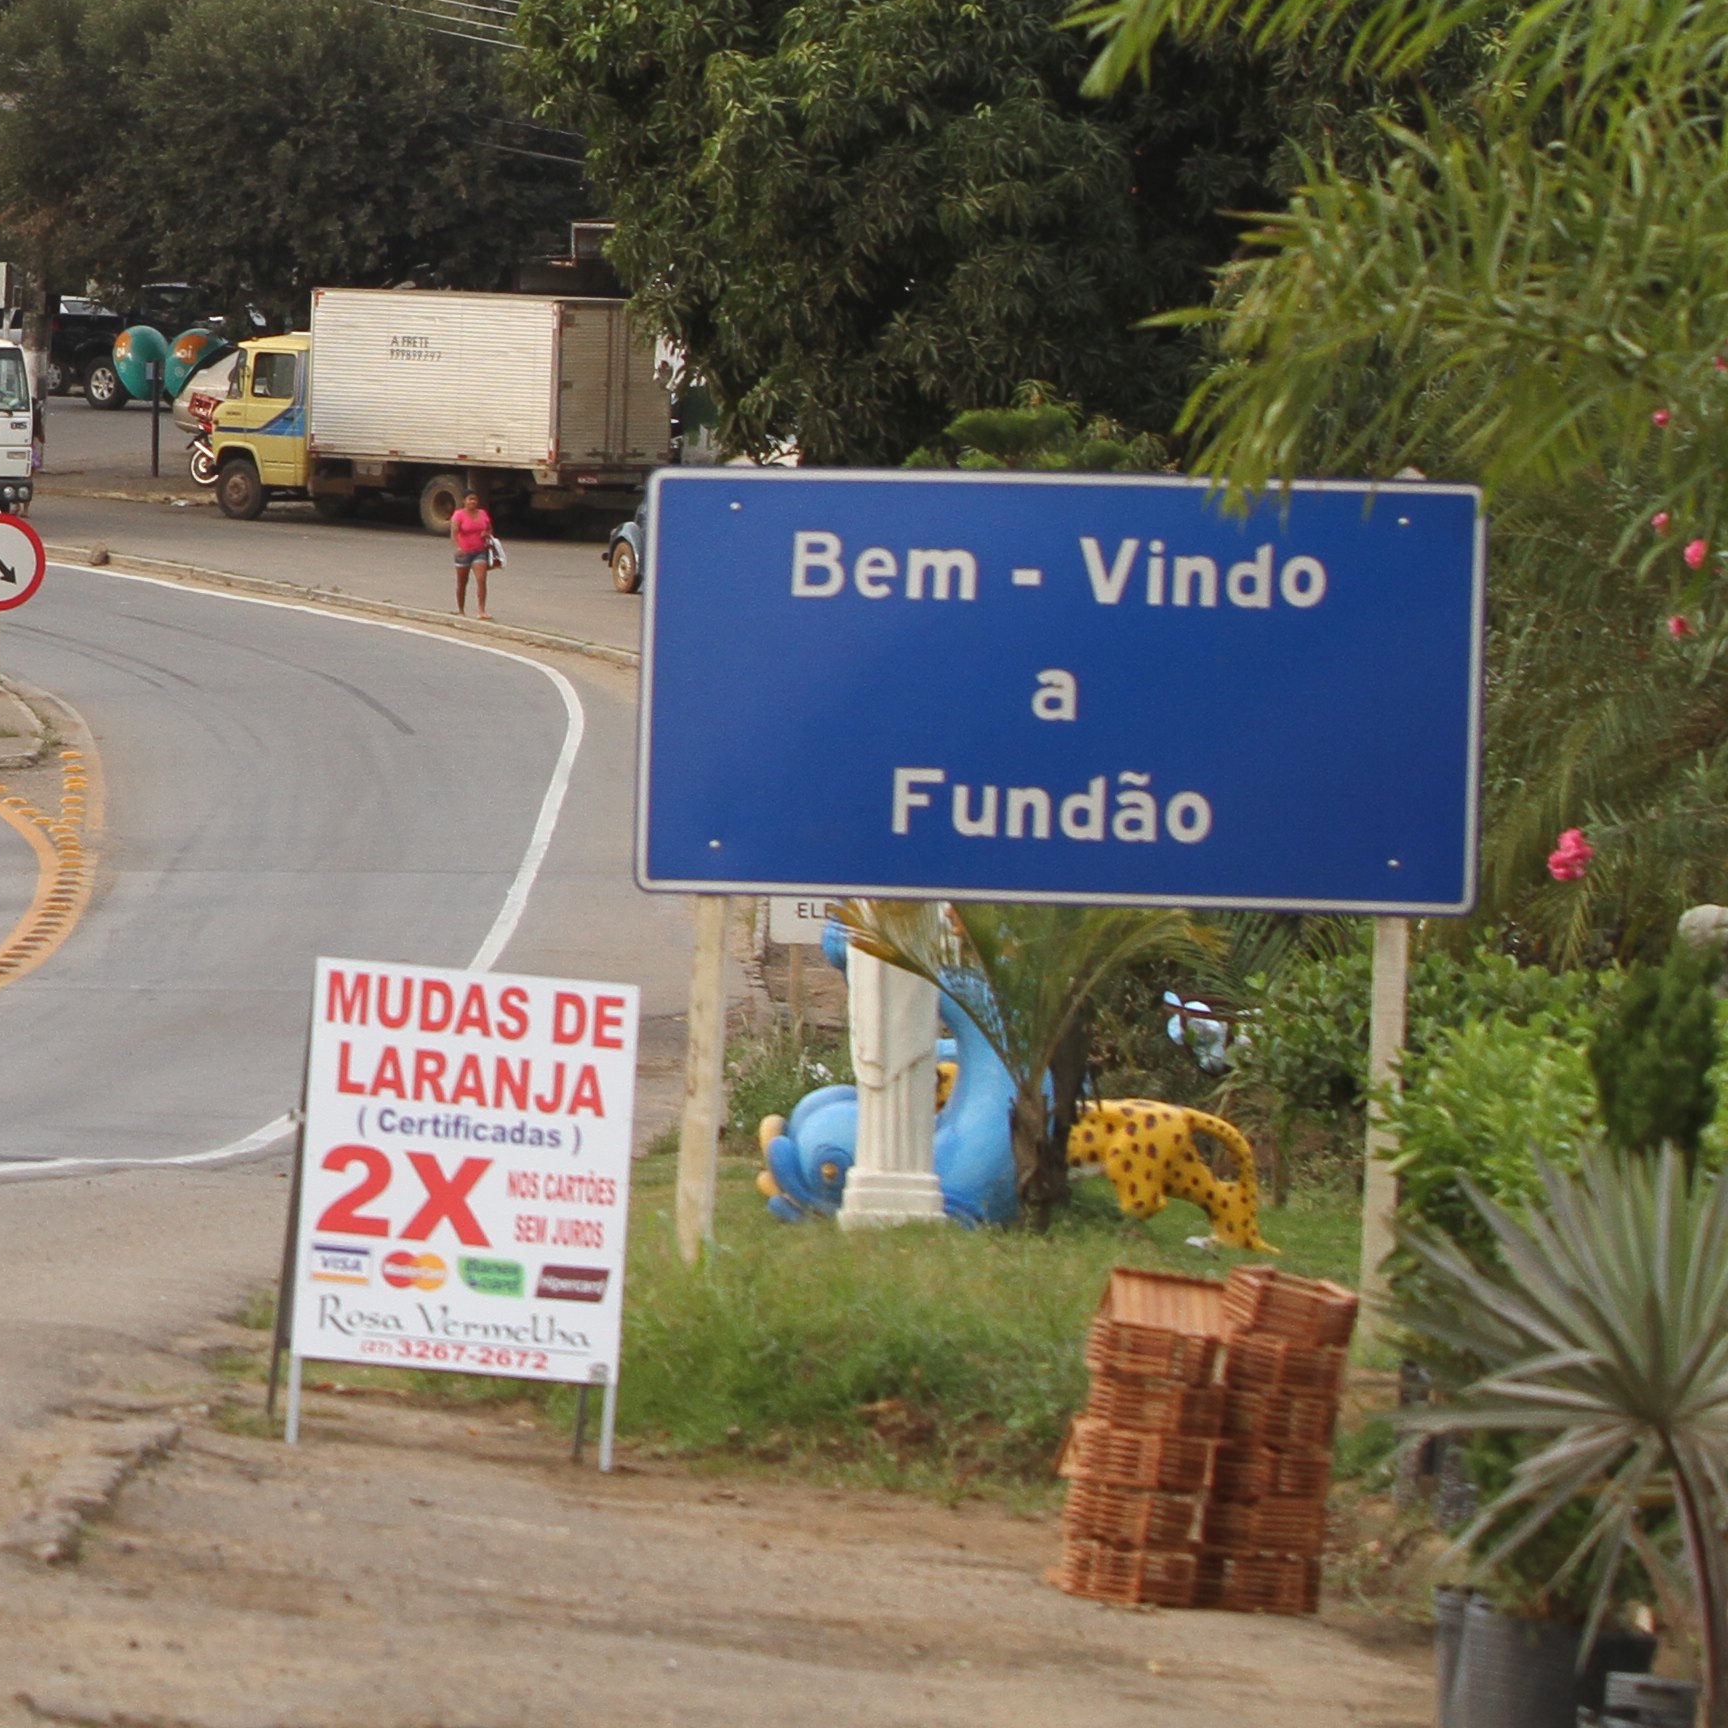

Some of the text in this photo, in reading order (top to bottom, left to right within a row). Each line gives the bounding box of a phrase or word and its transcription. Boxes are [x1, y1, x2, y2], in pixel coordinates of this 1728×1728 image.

[790, 530, 978, 601] Bem
[1079, 536, 1328, 609] Vindo
[1031, 668, 1078, 722] a
[891, 767, 1213, 844] Fundão
[326, 969, 626, 1050] MUDAS DE
[337, 1041, 606, 1118] LARANJA
[377, 1108, 562, 1148] Certificadas
[315, 1143, 495, 1249] 2X
[507, 1170, 618, 1207] NOS CARTÕES
[514, 1214, 605, 1250] SEM JUROS
[321, 1256, 363, 1273] VISA
[319, 1294, 591, 1349] Rosa Vermelha
[396, 1339, 549, 1371] 3267-2672
